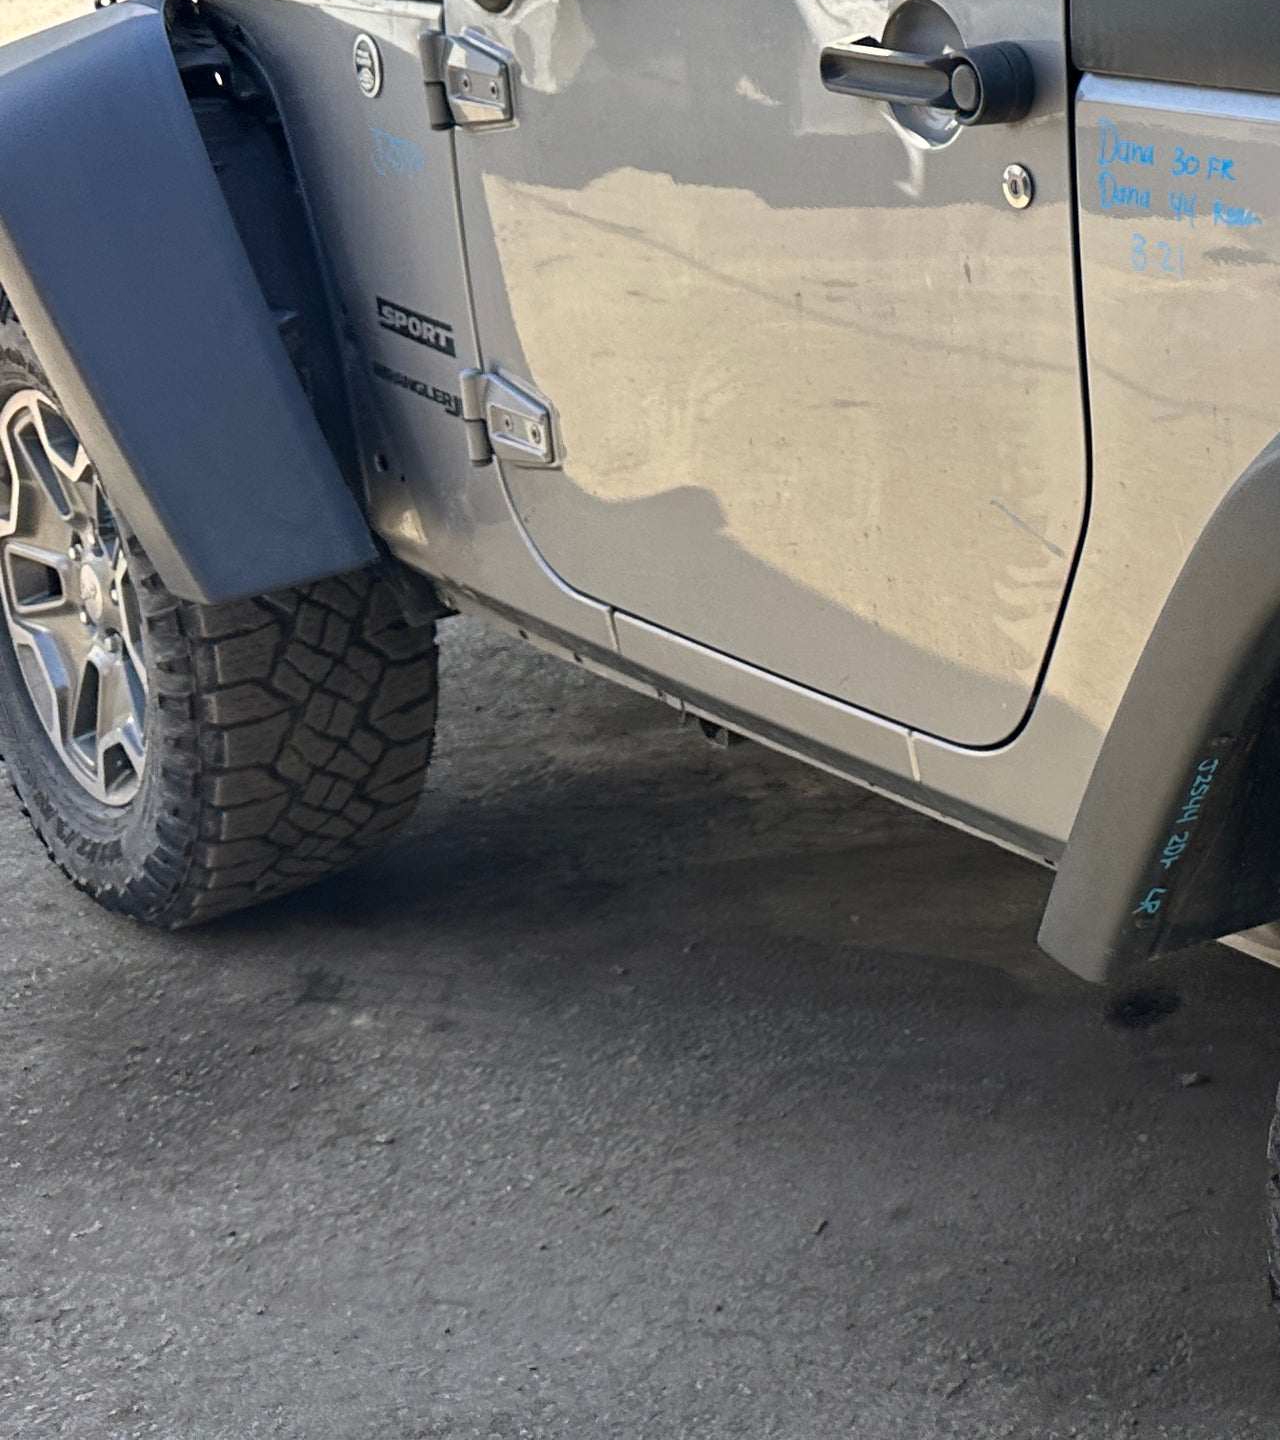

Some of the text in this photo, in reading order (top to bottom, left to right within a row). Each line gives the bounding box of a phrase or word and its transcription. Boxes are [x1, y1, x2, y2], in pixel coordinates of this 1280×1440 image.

[1097, 117, 1155, 168] Dana
[1171, 146, 1200, 176] 30
[1169, 190, 1197, 229] 44
[381, 305, 453, 348] SPORT
[1176, 759, 1219, 824] J2544
